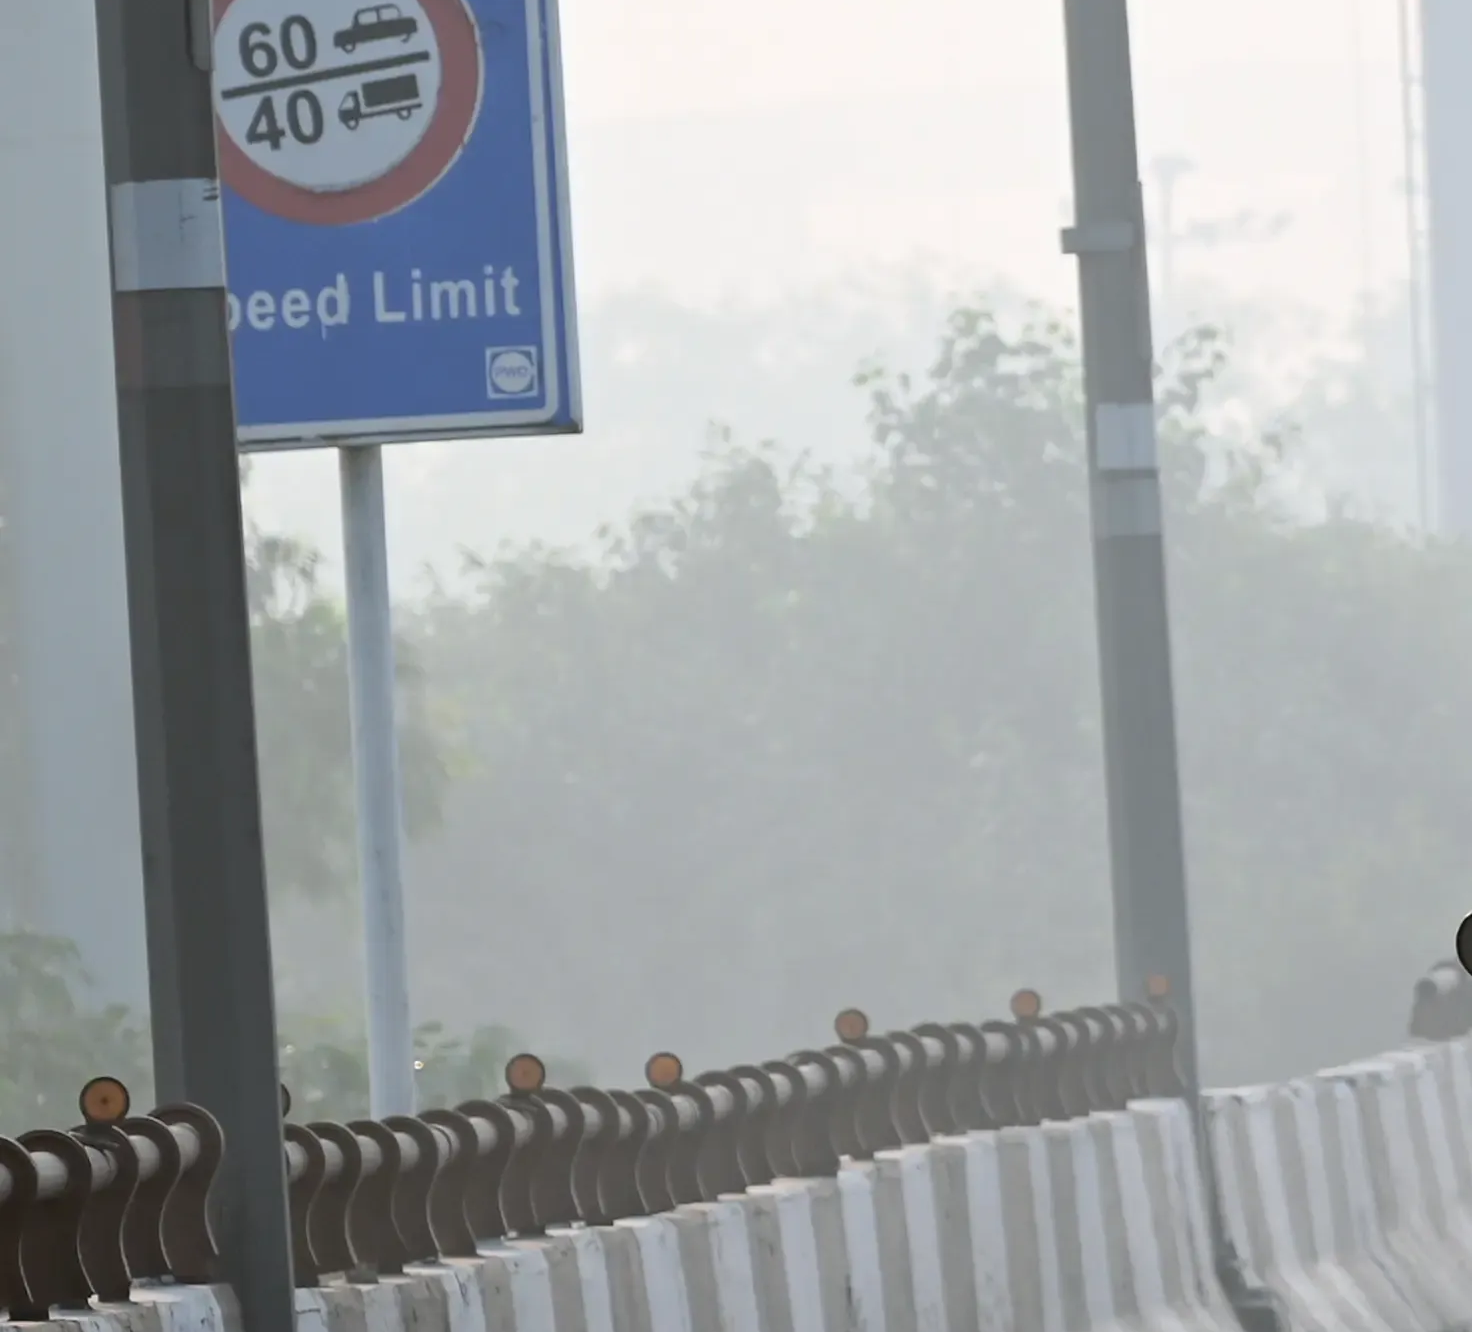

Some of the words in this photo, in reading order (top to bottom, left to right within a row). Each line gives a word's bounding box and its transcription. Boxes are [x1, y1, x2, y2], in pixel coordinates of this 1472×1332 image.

[238, 14, 318, 79] 60
[245, 89, 324, 151] 40
[227, 271, 350, 331] eed
[372, 265, 521, 323] Limit
